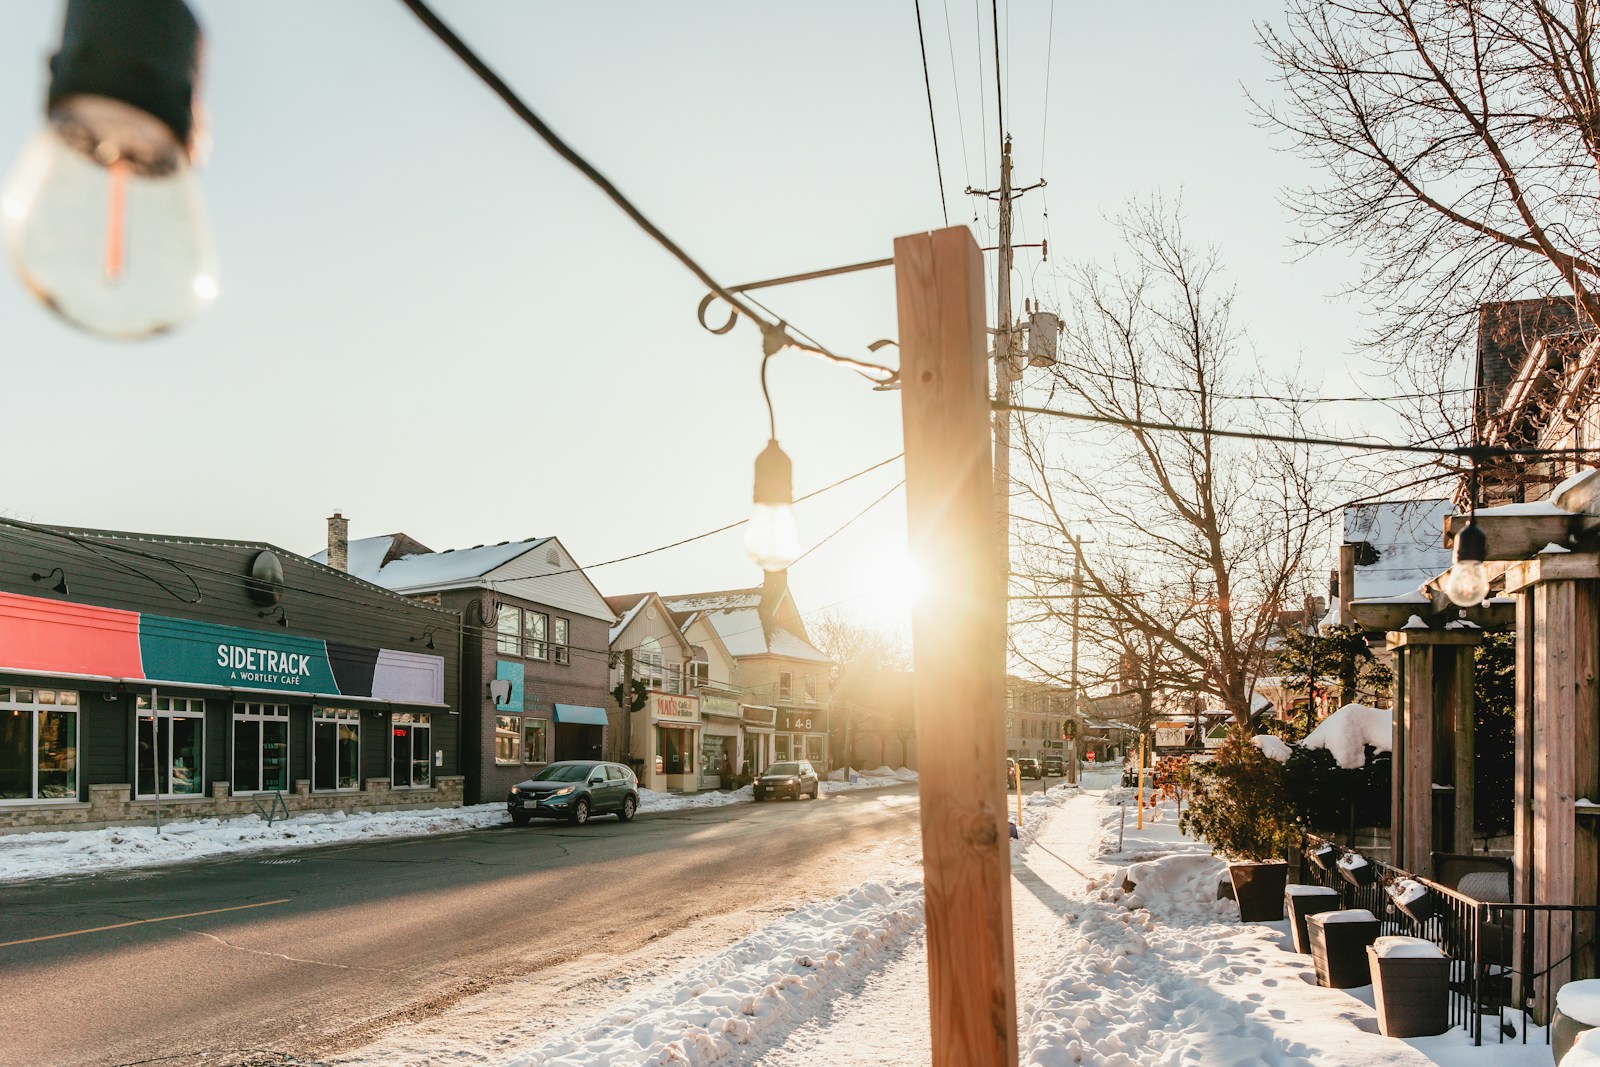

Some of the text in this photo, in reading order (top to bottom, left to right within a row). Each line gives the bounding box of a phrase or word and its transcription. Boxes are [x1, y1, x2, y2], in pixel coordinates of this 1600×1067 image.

[217, 644, 311, 676] SIDETRACK
[231, 671, 300, 685] A WORTLEY CAFÉ
